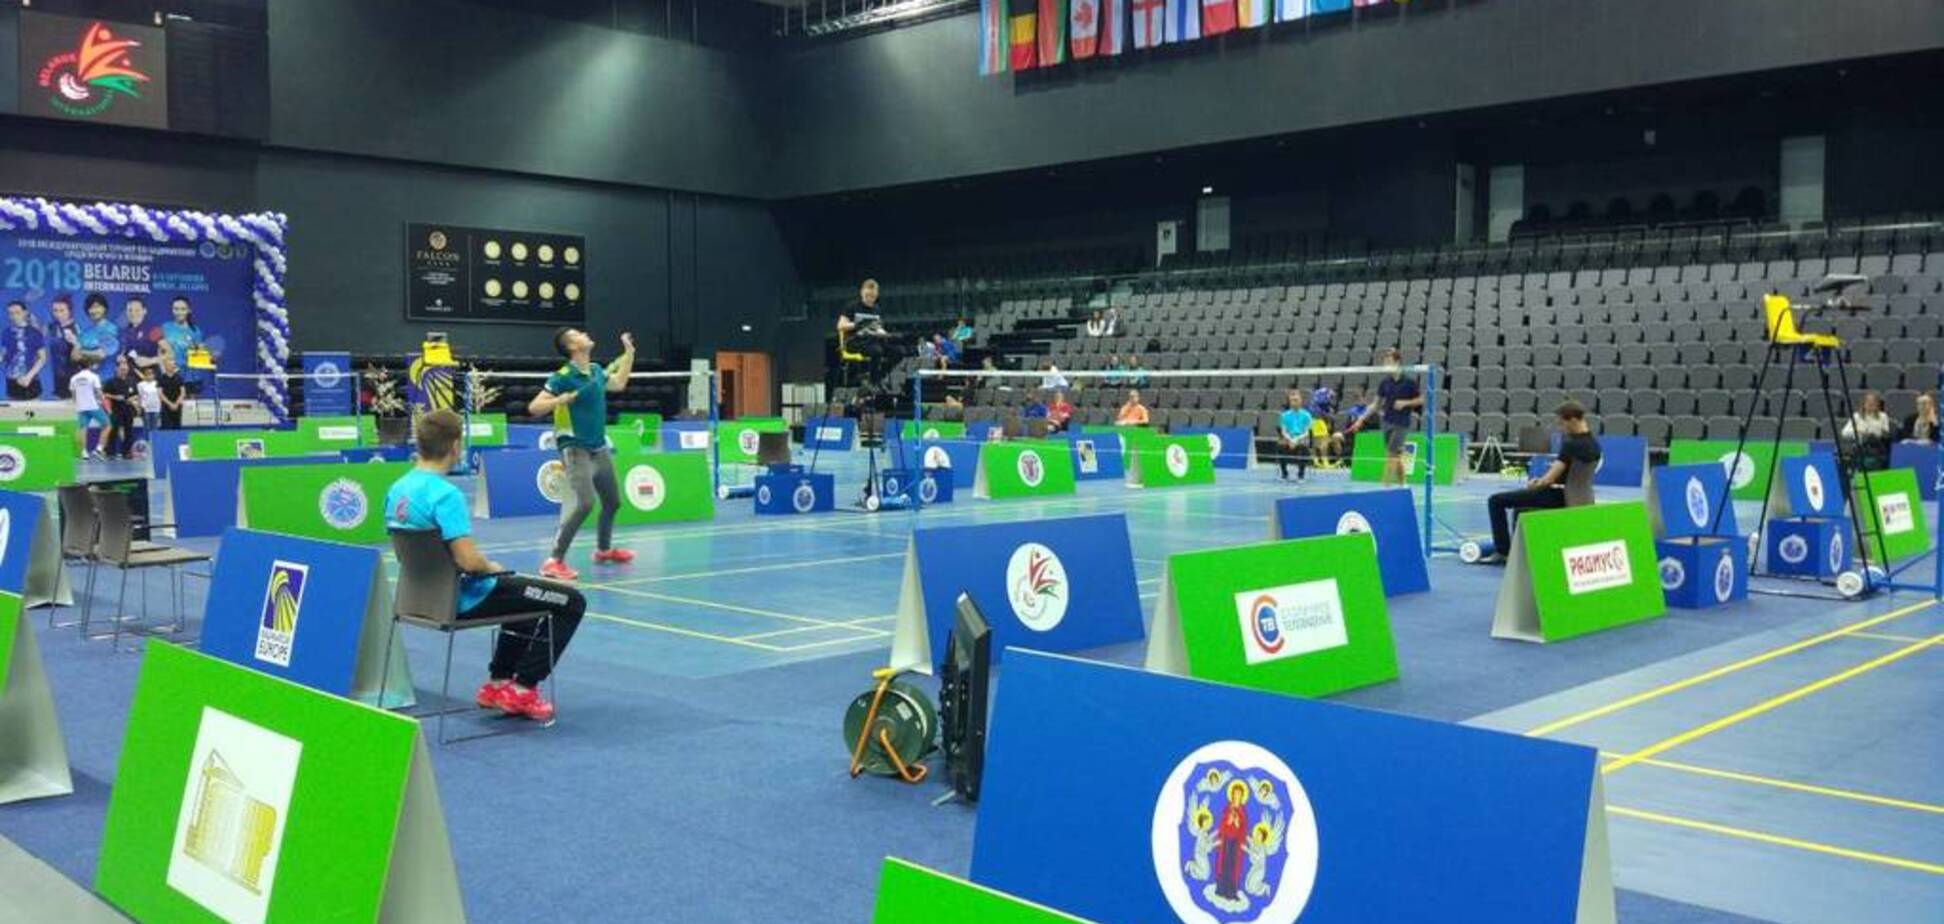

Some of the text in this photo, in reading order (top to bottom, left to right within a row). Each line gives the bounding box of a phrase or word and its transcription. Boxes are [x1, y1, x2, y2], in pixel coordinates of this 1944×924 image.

[416, 250, 460, 262] FALCON
[5, 258, 81, 290] 2018
[84, 263, 151, 281] BELARUS
